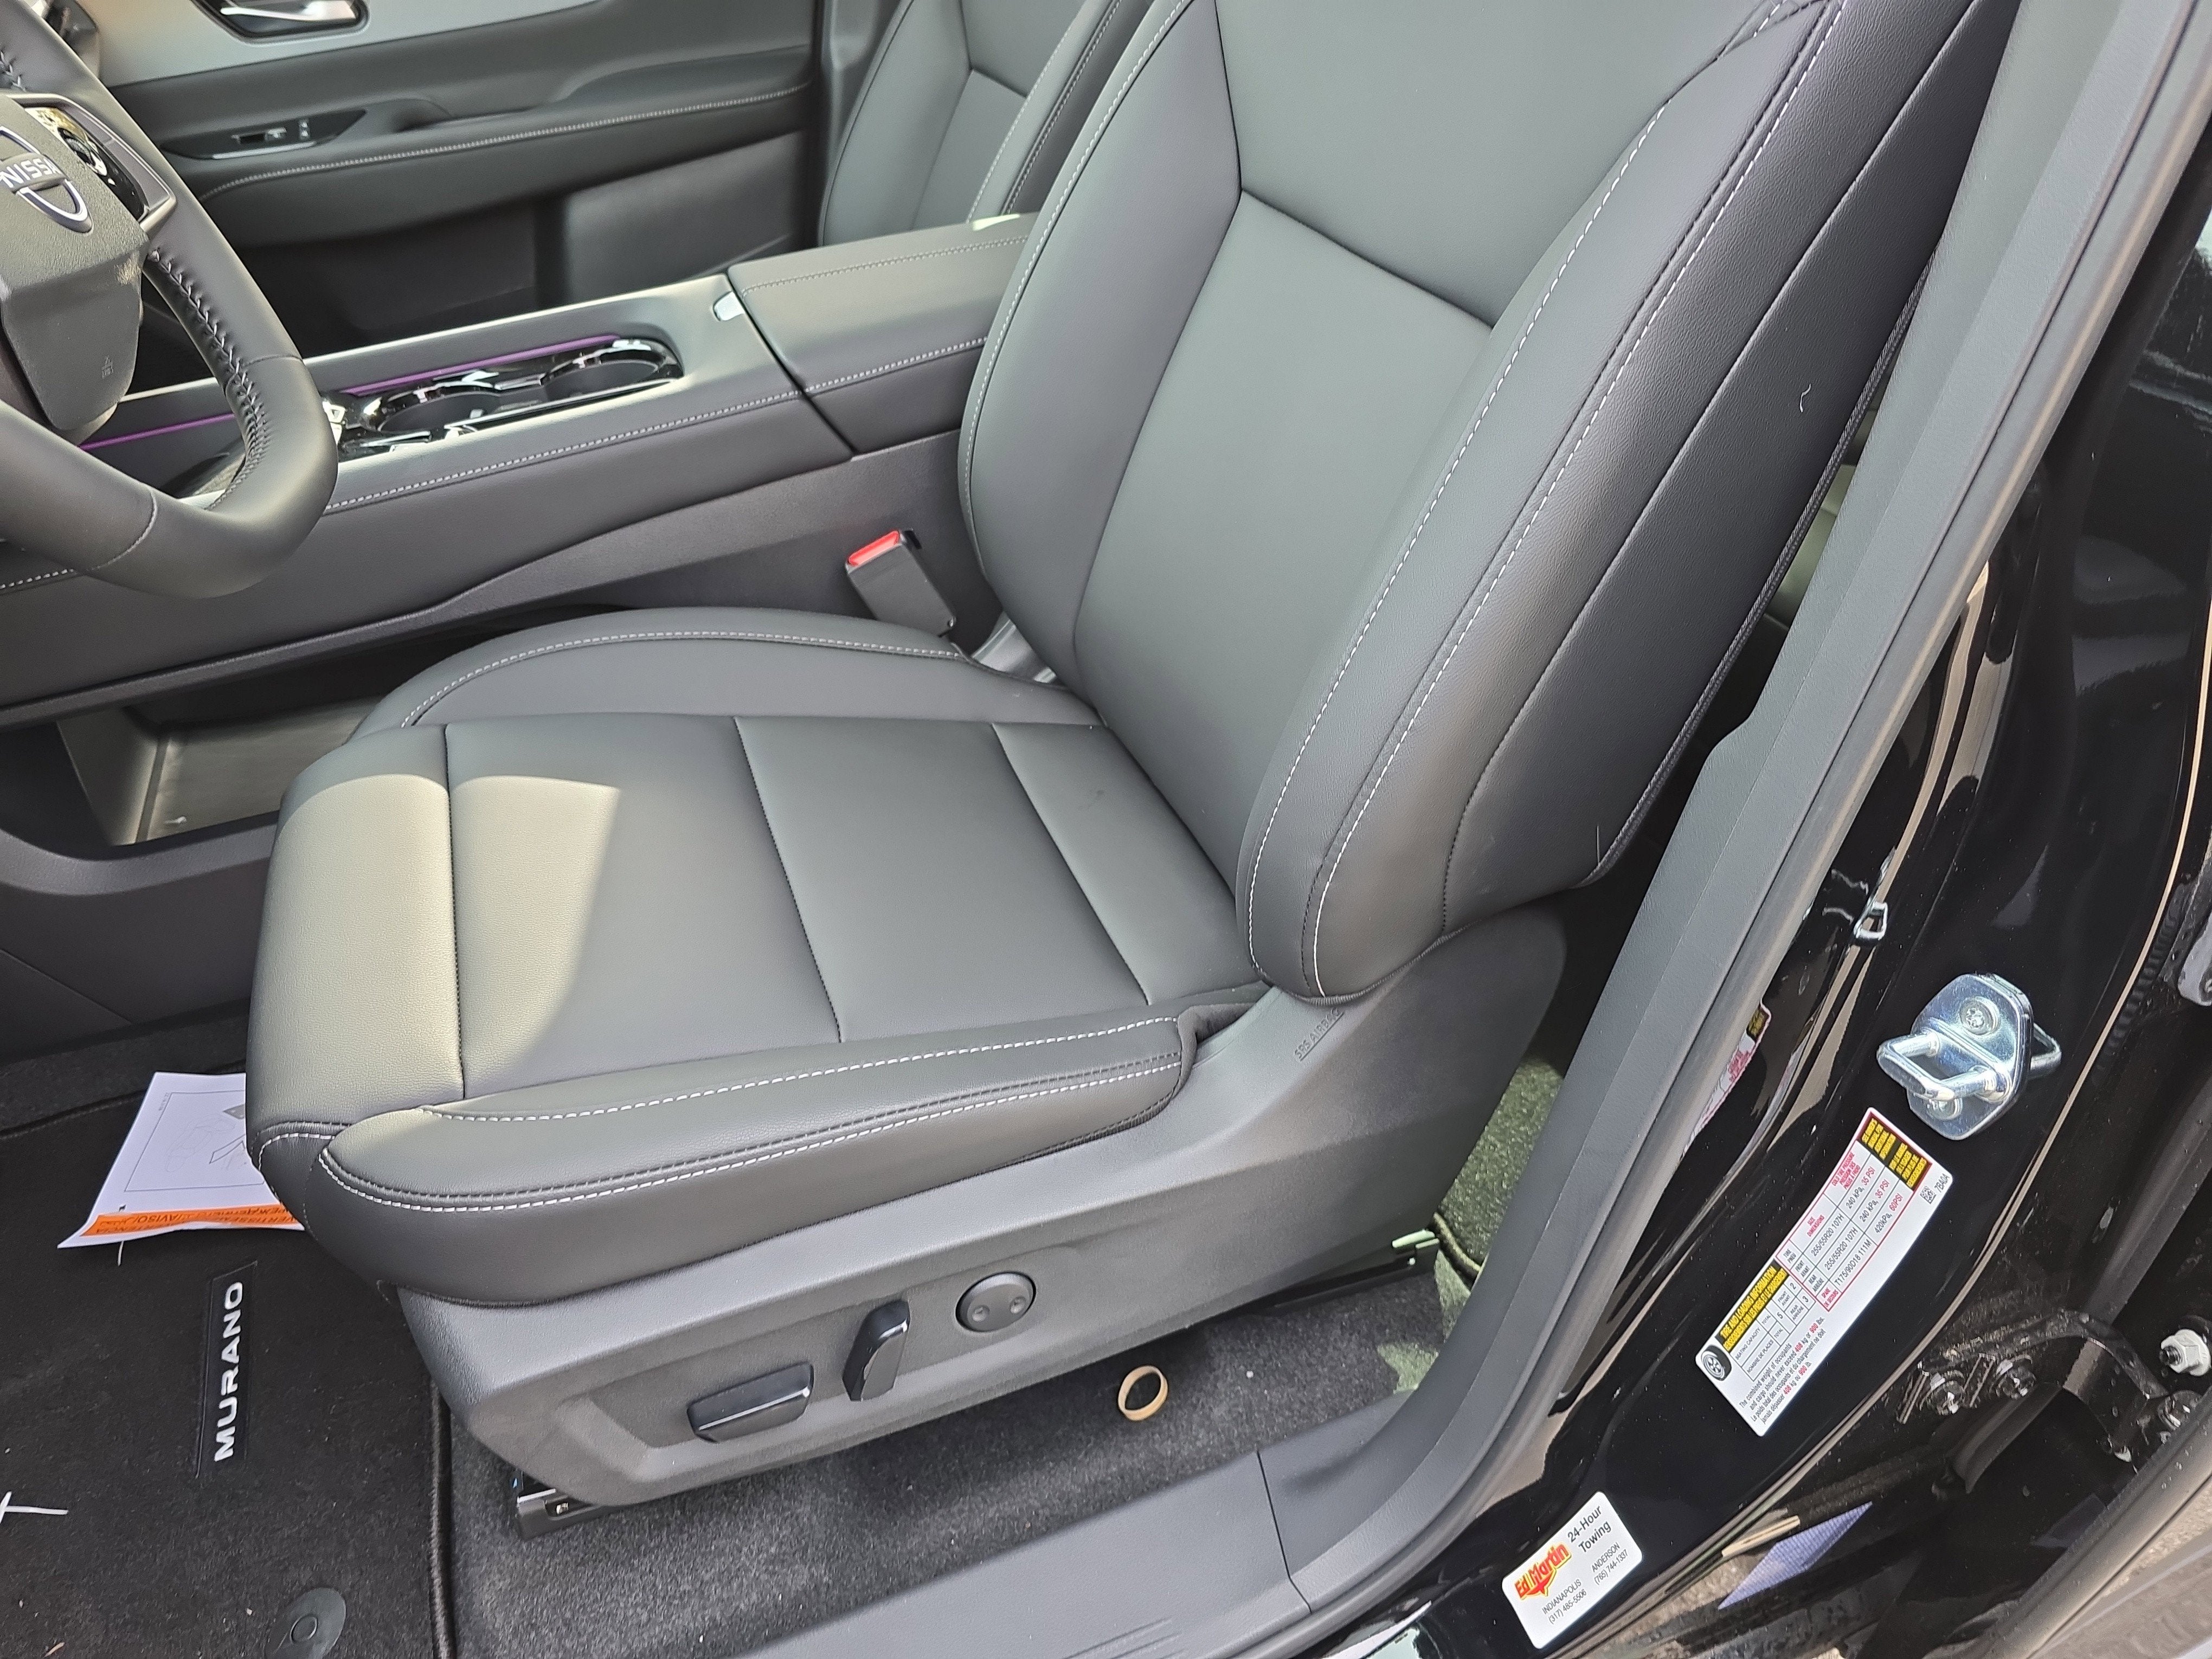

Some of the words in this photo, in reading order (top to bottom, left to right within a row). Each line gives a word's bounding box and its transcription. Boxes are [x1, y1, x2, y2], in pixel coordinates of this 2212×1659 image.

[0, 158, 62, 188] NISSA
[1846, 1195, 1856, 1209] 240
[1852, 1184, 1864, 1199] kPa,
[1861, 1175, 1869, 1186] 35
[1866, 1166, 1875, 1179] PSI
[1859, 1209, 1869, 1223] 240
[1866, 1197, 1879, 1212] kPa,
[1875, 1188, 1883, 1199] 35
[1879, 1178, 1889, 1191] PSI
[1874, 1210, 1892, 1234] 420kPa,
[1888, 1192, 1902, 1212] 60PSI
[1810, 1226, 1834, 1256] 255/55R20
[1831, 1213, 1844, 1229] 107H
[1823, 1240, 1848, 1270] 255/55R20
[1844, 1226, 1858, 1243] 107H
[1834, 1253, 1861, 1287] T175/90D18
[1857, 1238, 1872, 1256] 111M
[1719, 1323, 1733, 1339] TIRE
[1727, 1314, 1740, 1329] AND
[1734, 1294, 1754, 1320] LOADING
[1749, 1265, 1777, 1300] INFORMATION
[1789, 1282, 1796, 1290] 2
[1802, 1295, 1809, 1303] 3
[1761, 1313, 1771, 1325] TOTAL
[1773, 1327, 1783, 1339] TOTAL
[214, 1281, 243, 1462] MURANO
[1739, 1398, 1748, 1409] The
[1745, 1380, 1762, 1401] combined
[1759, 1366, 1773, 1384] weight
[1769, 1361, 1777, 1370] of
[1773, 1342, 1792, 1365] occupants
[1748, 1400, 1758, 1411] and
[1756, 1389, 1767, 1404] cargo
[1764, 1375, 1777, 1391] should
[1774, 1364, 1786, 1378] never
[1783, 1350, 1797, 1367] exceed
[1793, 1342, 1803, 1353] 408
[1800, 1336, 1809, 1345] kg
[1809, 1322, 1818, 1334] 900
[1816, 1315, 1824, 1325] lbs.
[1750, 1413, 1757, 1422] Le
[1754, 1404, 1765, 1418] poids
[1761, 1396, 1771, 1407] total
[1768, 1389, 1777, 1399] des
[1774, 1371, 1791, 1393] occupants
[1791, 1361, 1799, 1370] du
[1796, 1340, 1816, 1366] chargement
[1816, 1328, 1825, 1339] doit
[1760, 1409, 1773, 1425] jamais
[1770, 1392, 1786, 1412] dépasser
[1783, 1384, 1792, 1396] 408
[1789, 1379, 1797, 1387] kg
[1794, 1373, 1801, 1381] ou
[1798, 1365, 1808, 1375] 900
[1566, 1505, 1603, 1543] 24-Hour
[1578, 1520, 1612, 1554] Towing
[1514, 1576, 1530, 1598] Ed
[1526, 1543, 1570, 1586] Martin
[1590, 1541, 1621, 1573] ANDERSON
[1593, 1568, 1608, 1585] (765)
[1606, 1548, 1629, 1573] 744-1337
[1541, 1578, 1581, 1615] INDIANAPOLIS
[1548, 1607, 1564, 1625] (317)
